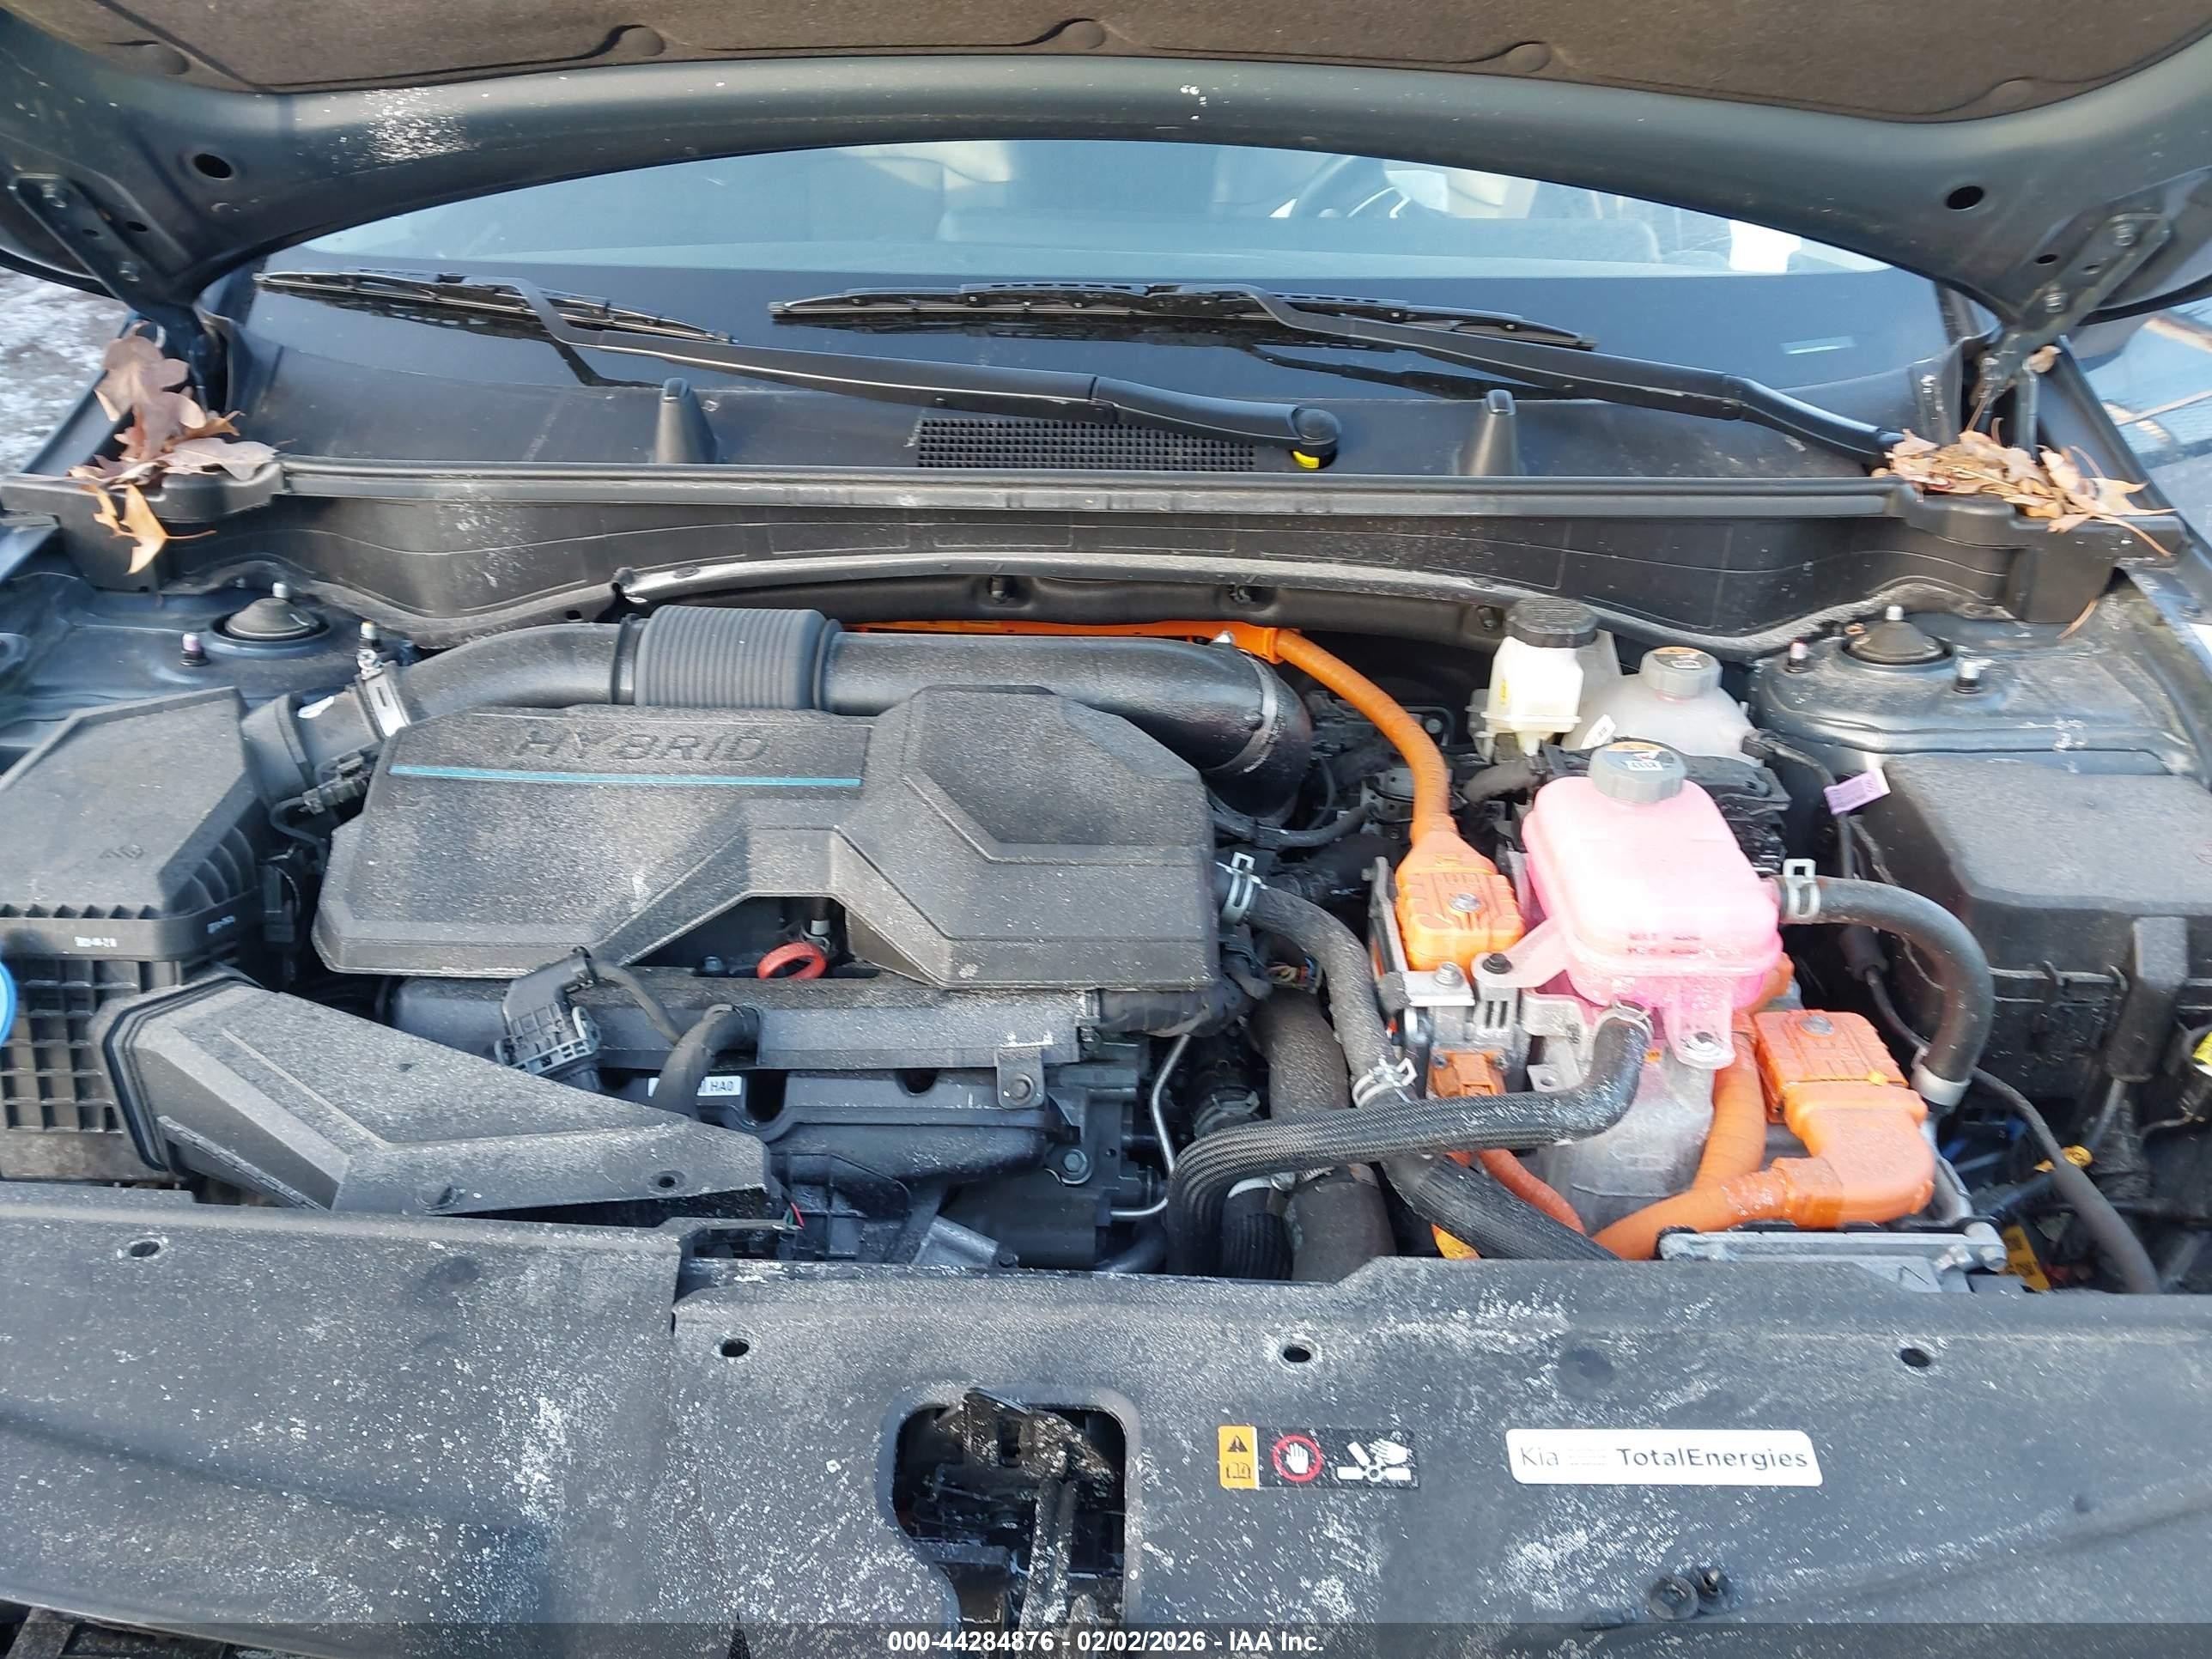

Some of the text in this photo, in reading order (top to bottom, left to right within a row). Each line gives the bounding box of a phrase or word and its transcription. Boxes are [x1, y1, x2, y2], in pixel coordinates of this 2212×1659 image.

[513, 729, 771, 762] HYBRID
[1519, 1446, 1559, 1467] Kia
[1615, 1447, 1809, 1471] TotalEnergies
